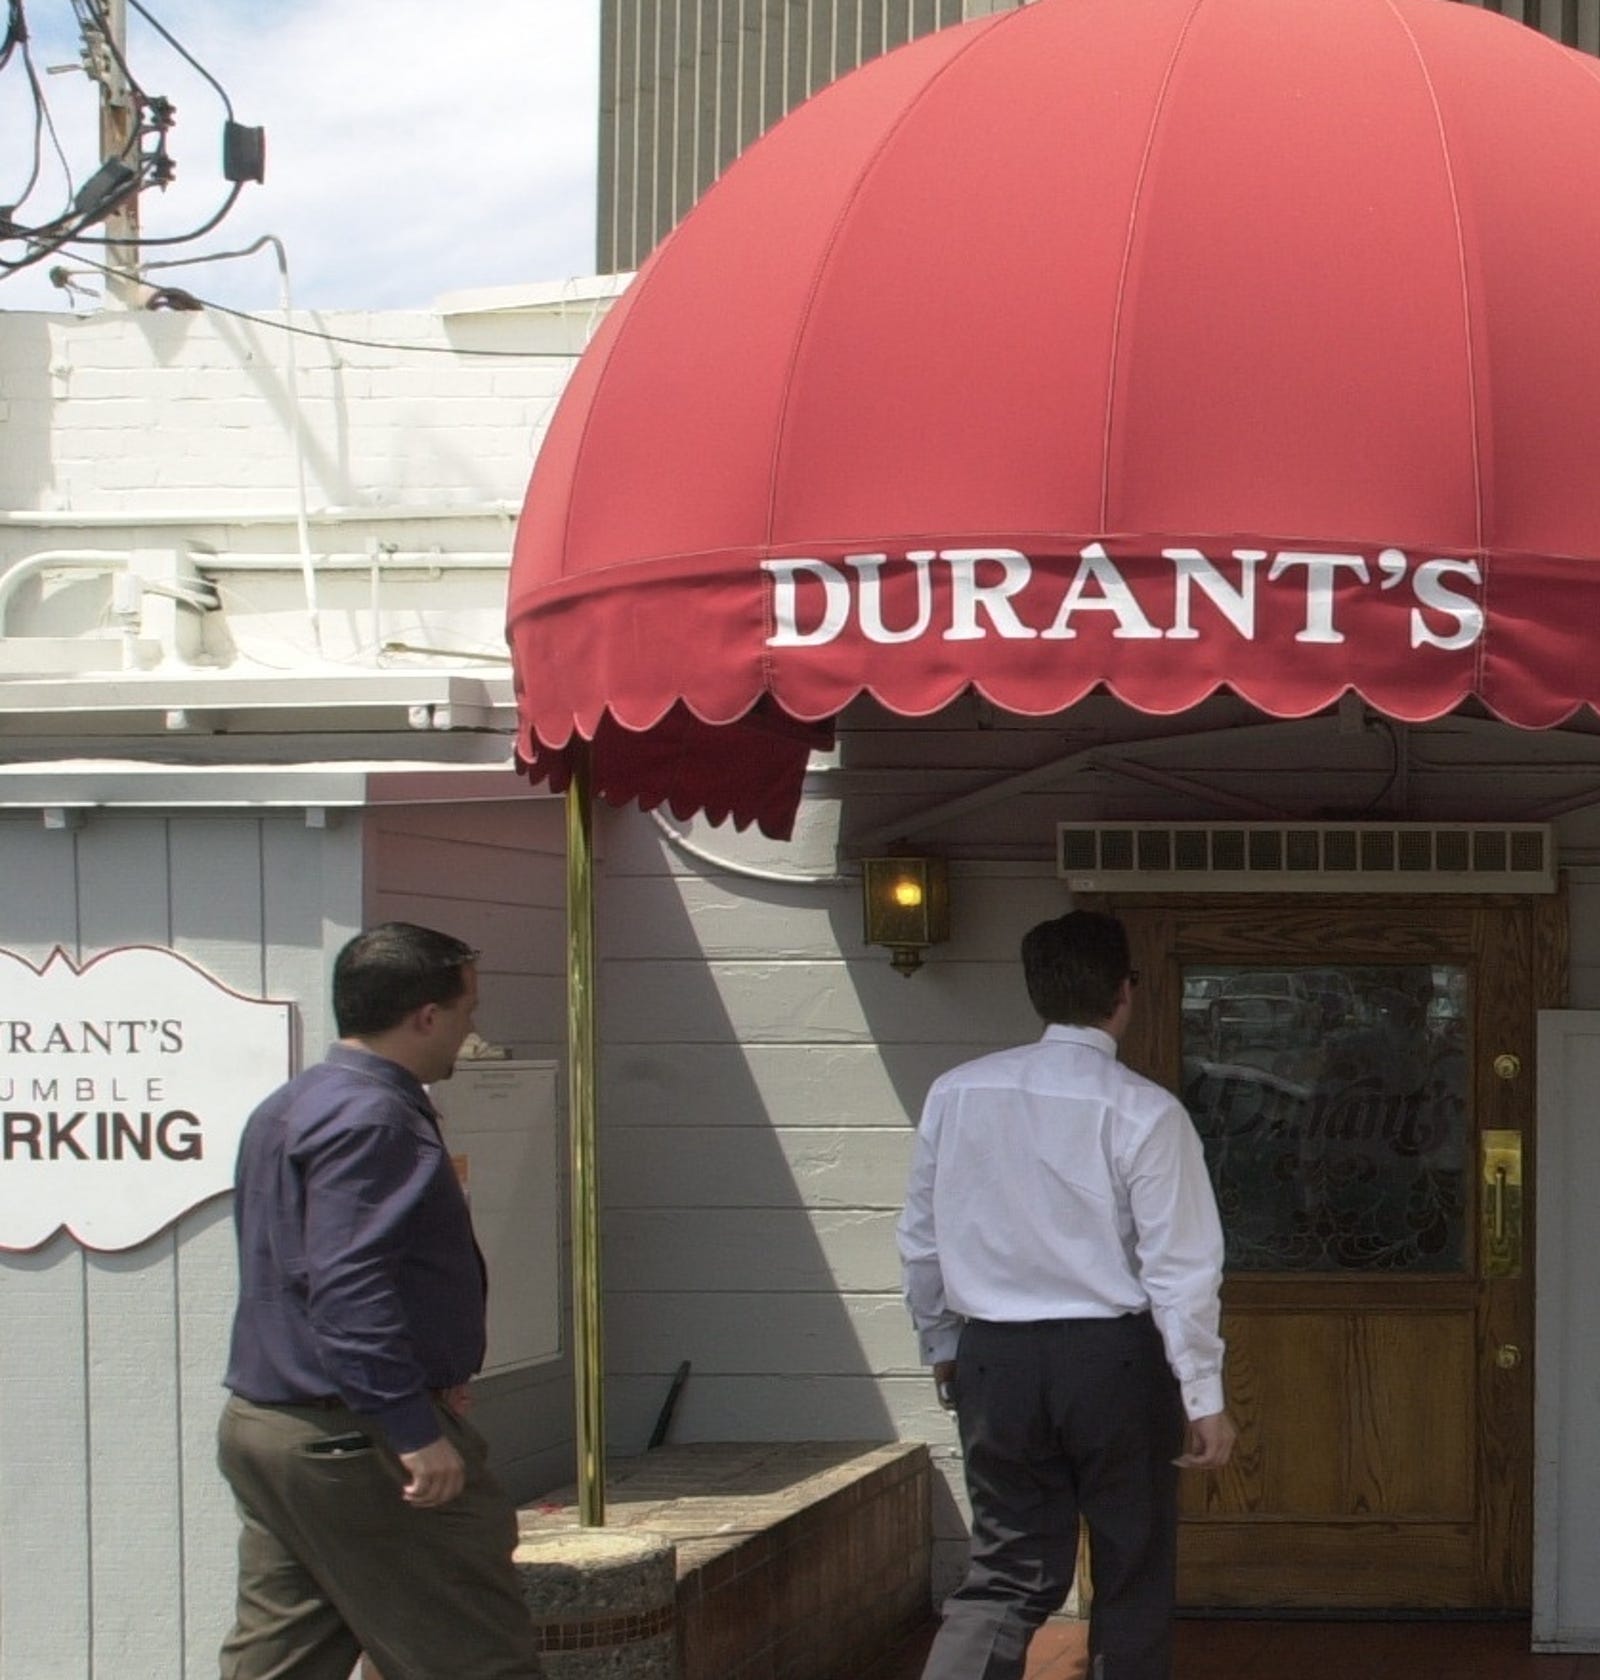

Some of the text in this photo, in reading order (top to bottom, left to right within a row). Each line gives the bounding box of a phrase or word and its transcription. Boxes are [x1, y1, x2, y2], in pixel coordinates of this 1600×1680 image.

[761, 542, 1483, 650] DURANT'S
[0, 1020, 184, 1055] RANT'S
[3, 1109, 204, 1162] RKING
